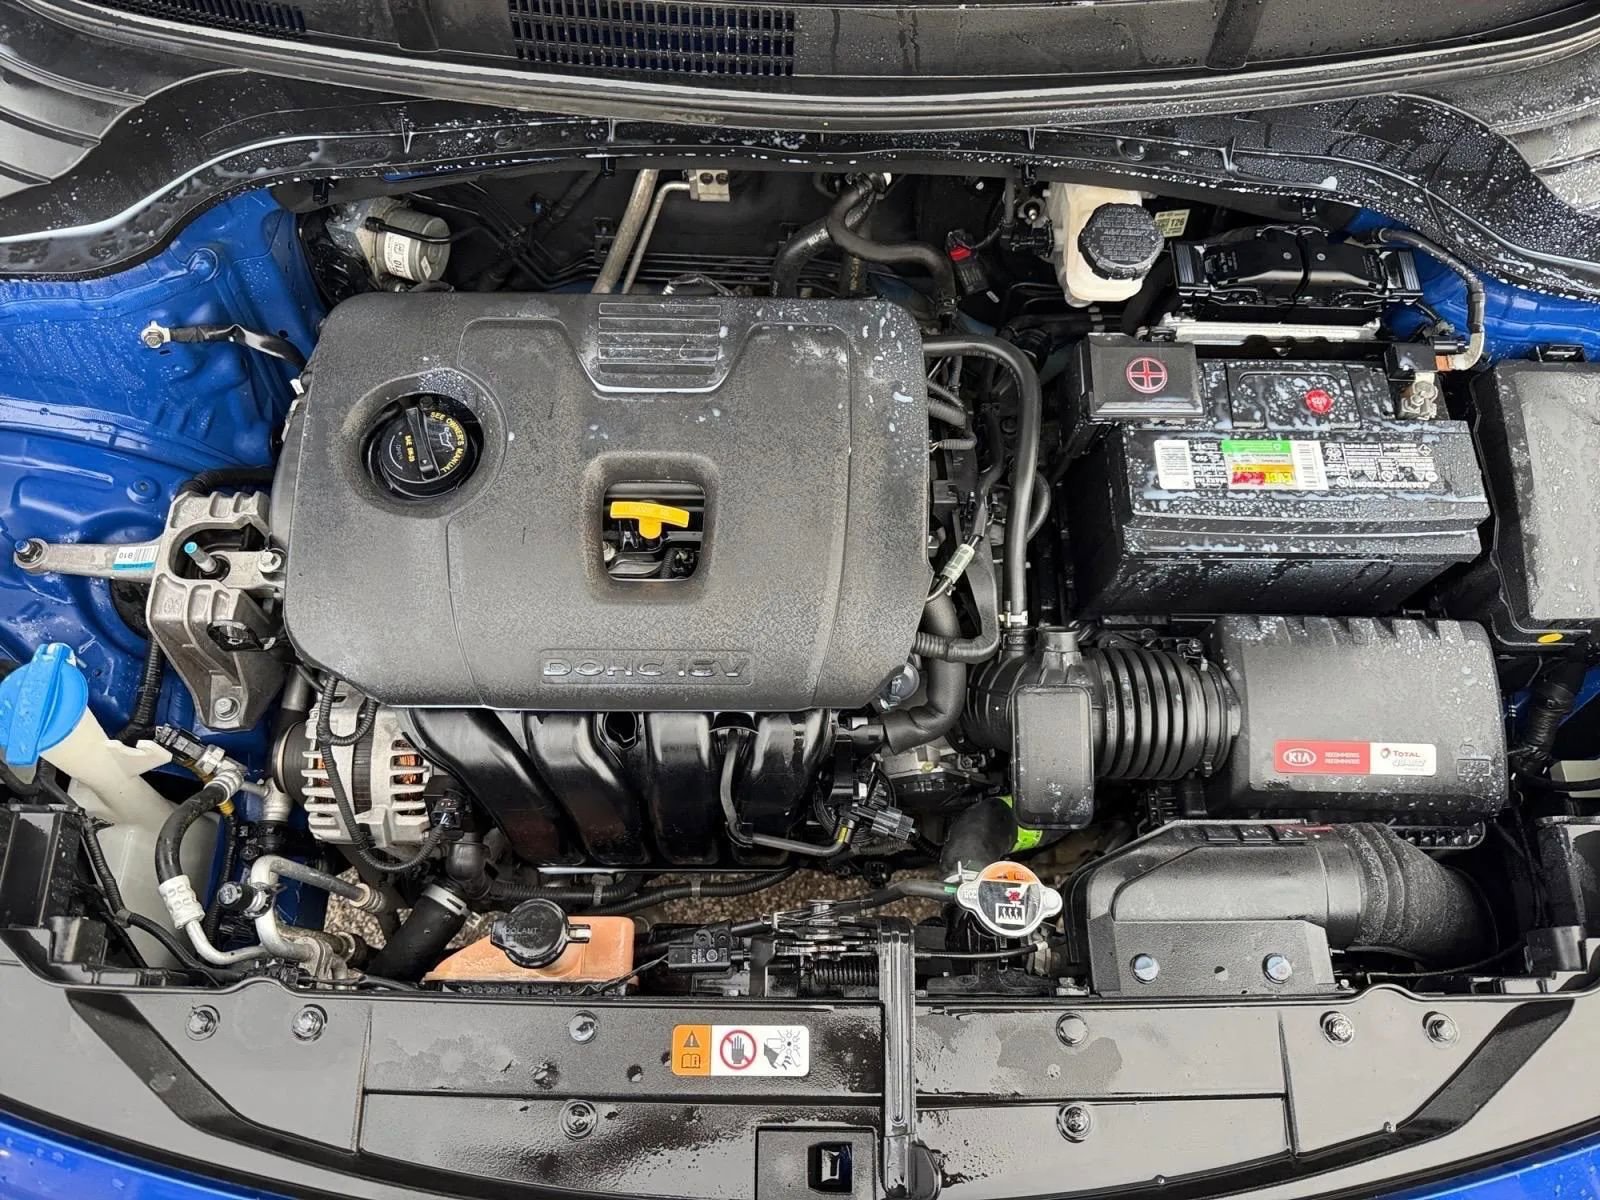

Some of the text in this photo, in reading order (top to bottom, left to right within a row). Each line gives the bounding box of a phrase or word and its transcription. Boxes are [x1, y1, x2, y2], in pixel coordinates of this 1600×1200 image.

[430, 411, 465, 473] SEE OWNER'S MANUAL
[544, 658, 664, 677] DOHC
[1288, 751, 1312, 764] KIA
